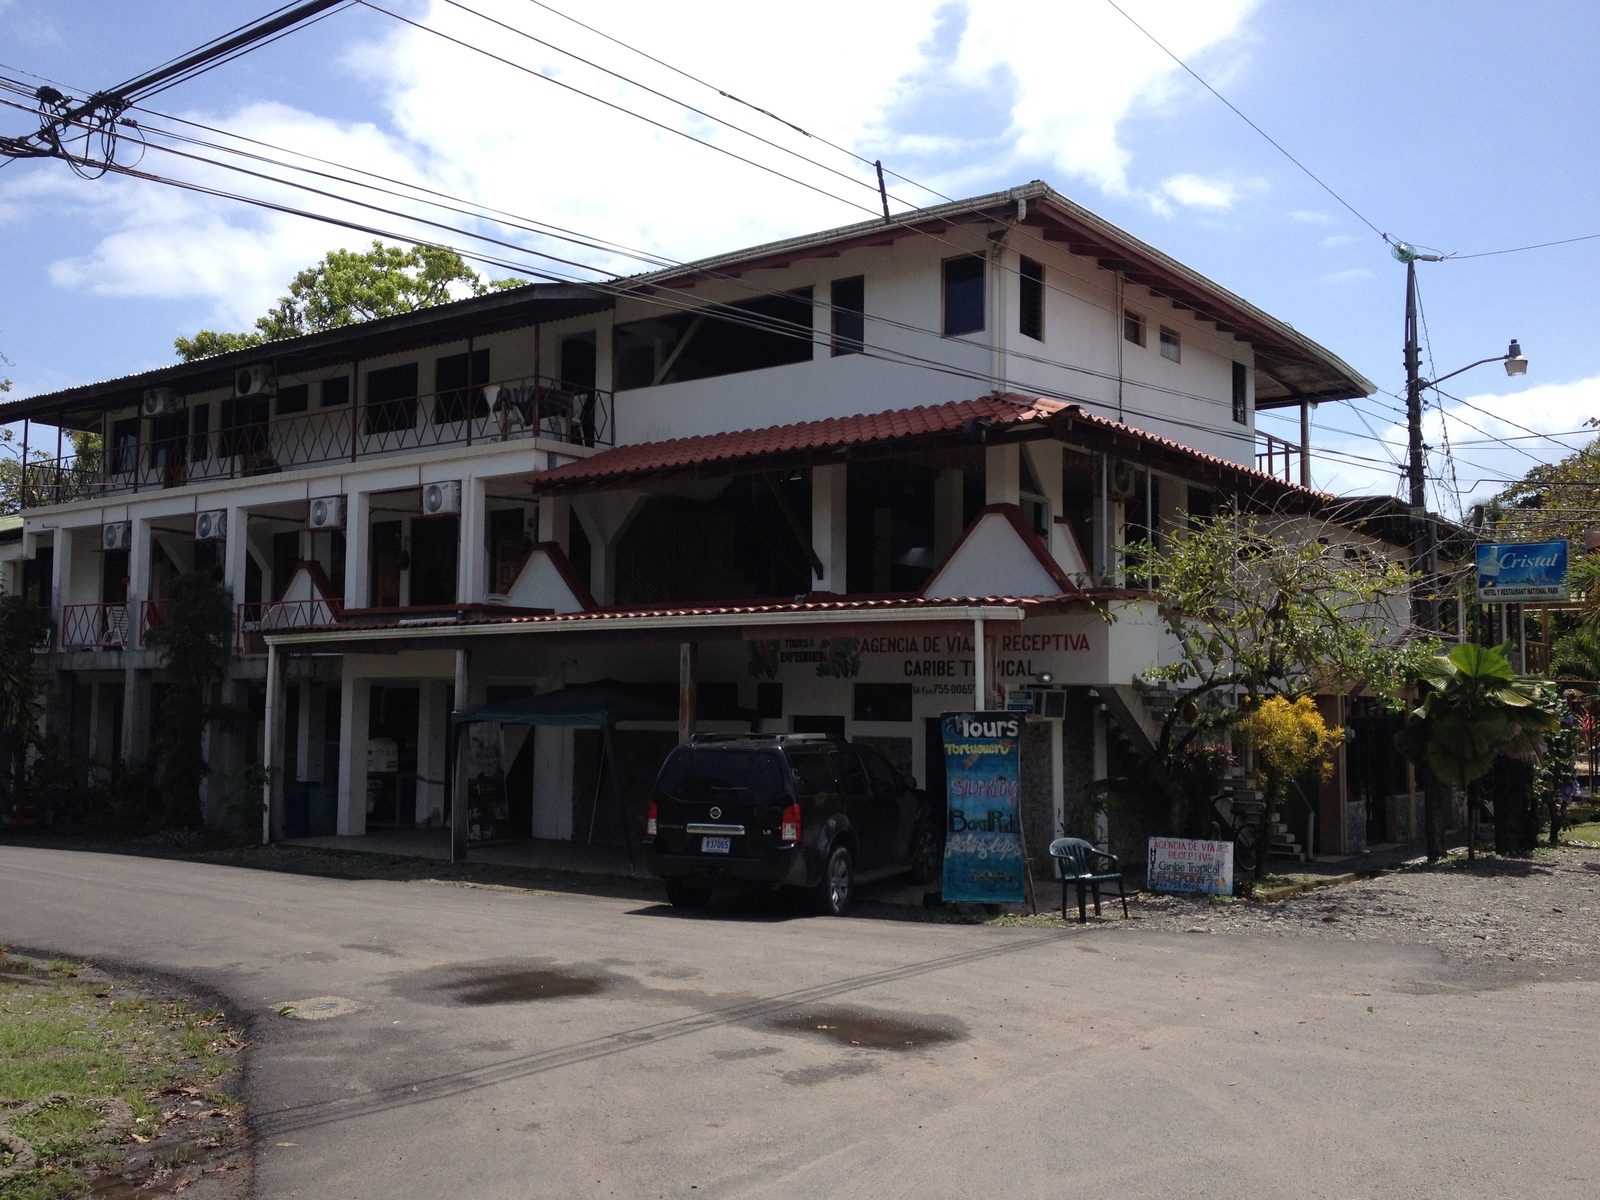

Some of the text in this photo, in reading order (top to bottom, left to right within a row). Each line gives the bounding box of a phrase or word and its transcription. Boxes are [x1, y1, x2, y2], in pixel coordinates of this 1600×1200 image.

[1499, 552, 1559, 569] Cristal
[1501, 588, 1527, 596] RESTAURANT
[1527, 587, 1547, 595] NATIONAL
[860, 636, 919, 653] AGENCIA
[923, 636, 941, 652] DE
[1002, 634, 1090, 652] RECEPTIVA
[780, 651, 826, 663] EXPEDITION
[904, 660, 955, 677] CARIBE
[961, 719, 1020, 738] Tours
[1154, 841, 1230, 853] AGENCIA DE VIAJES
[1168, 851, 1213, 862] RECEPTIVA
